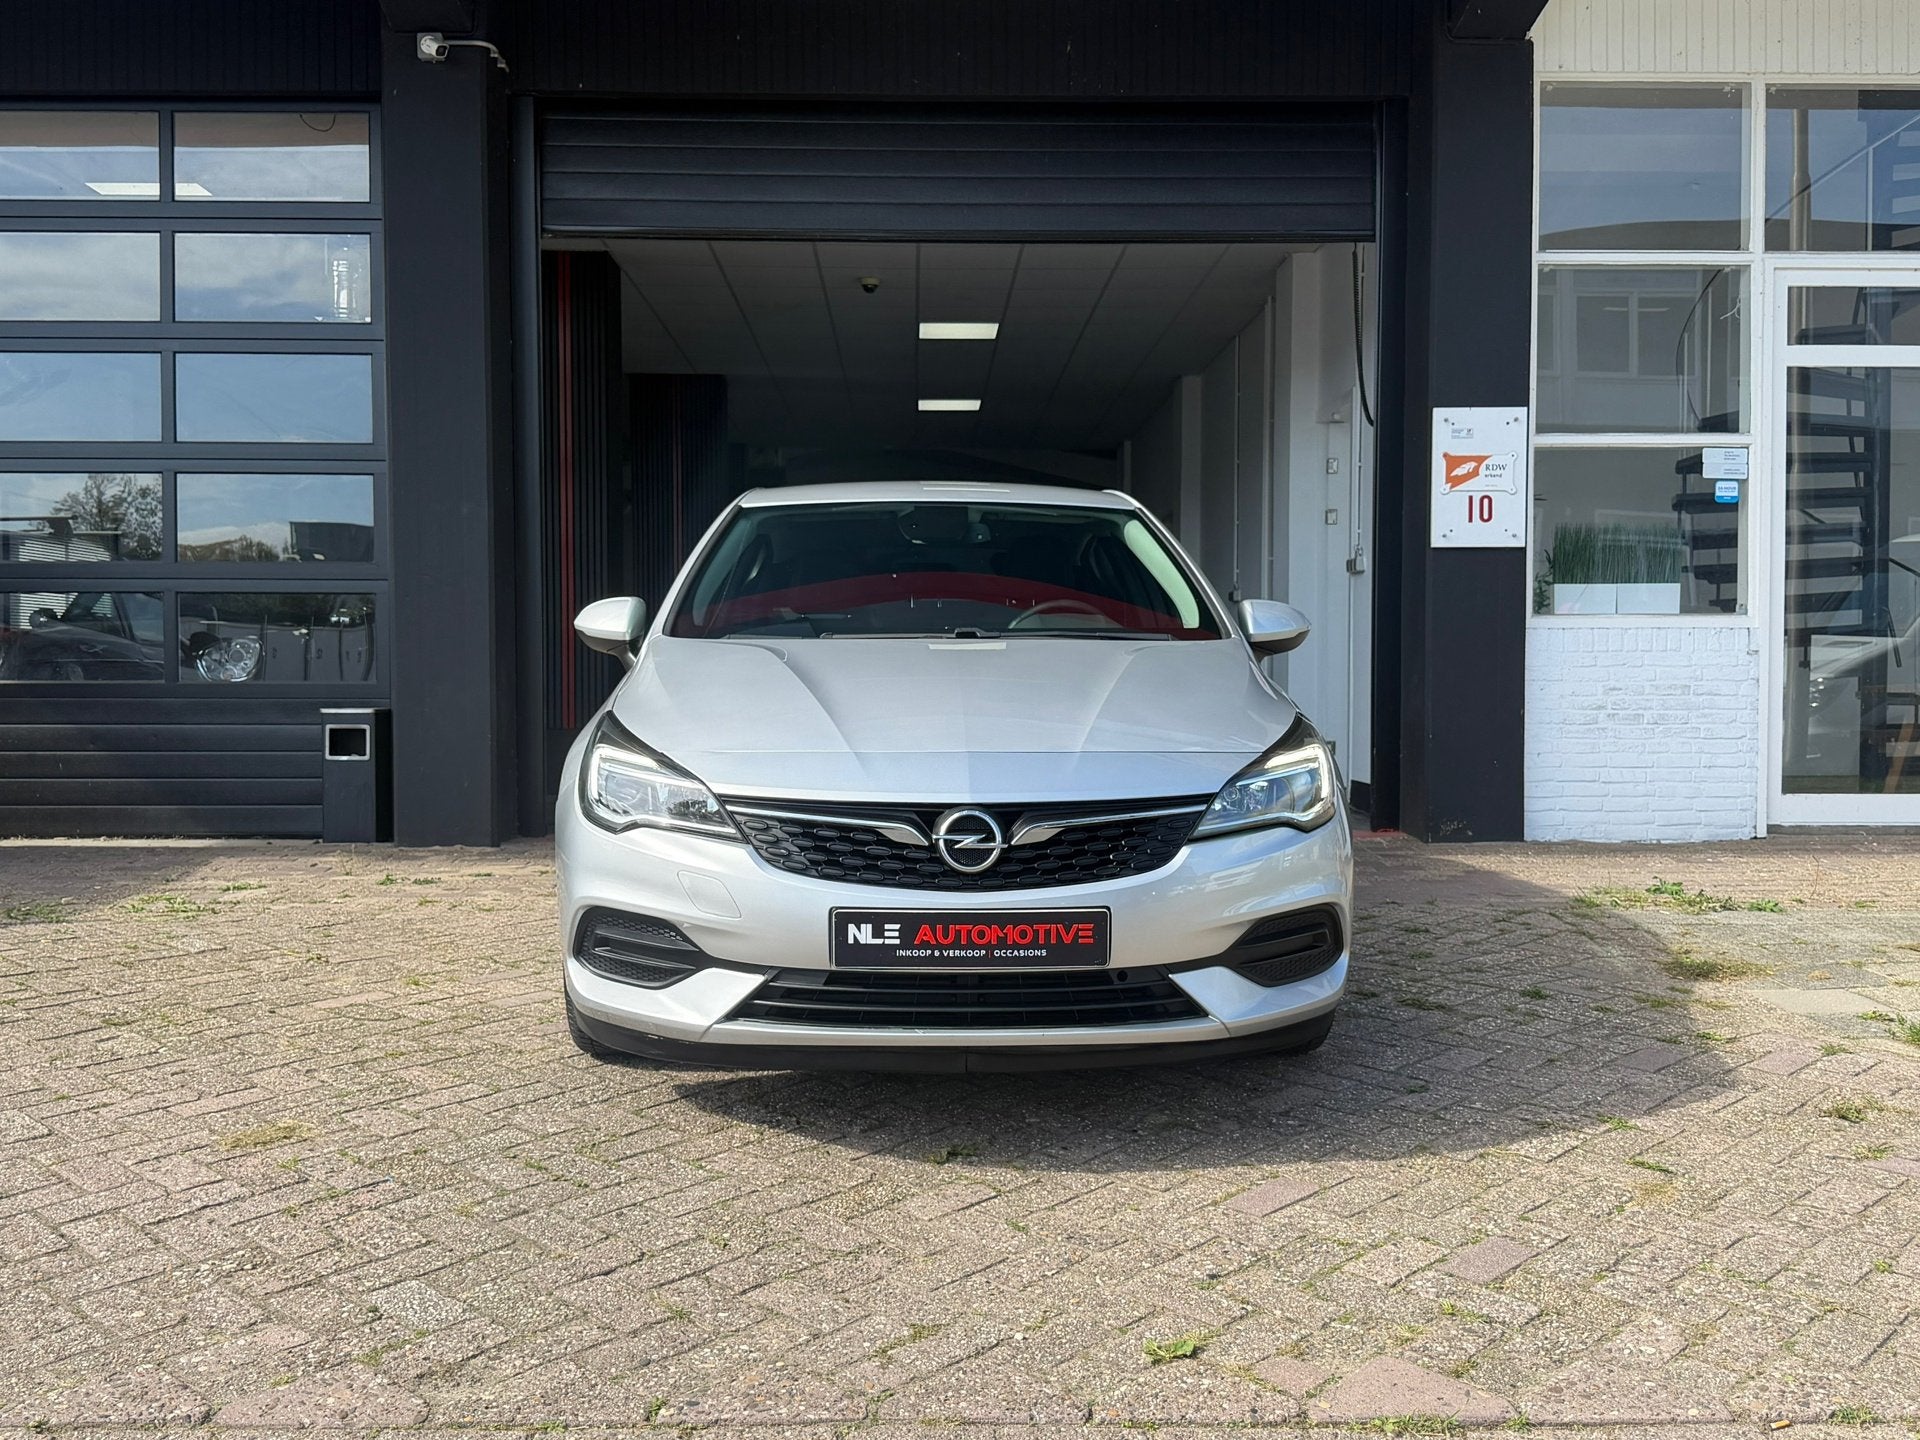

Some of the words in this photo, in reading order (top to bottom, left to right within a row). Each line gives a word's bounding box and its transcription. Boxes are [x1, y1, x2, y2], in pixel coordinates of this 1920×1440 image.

[1485, 463, 1508, 471] RDW
[1468, 495, 1493, 523] 10
[847, 923, 901, 945] NLE
[914, 923, 1094, 945] AUTOMOTIVE
[896, 949, 932, 957] INKOOP
[934, 949, 940, 957] &
[943, 949, 986, 957] VERKOOP
[993, 949, 1047, 957] OCCASIONS
